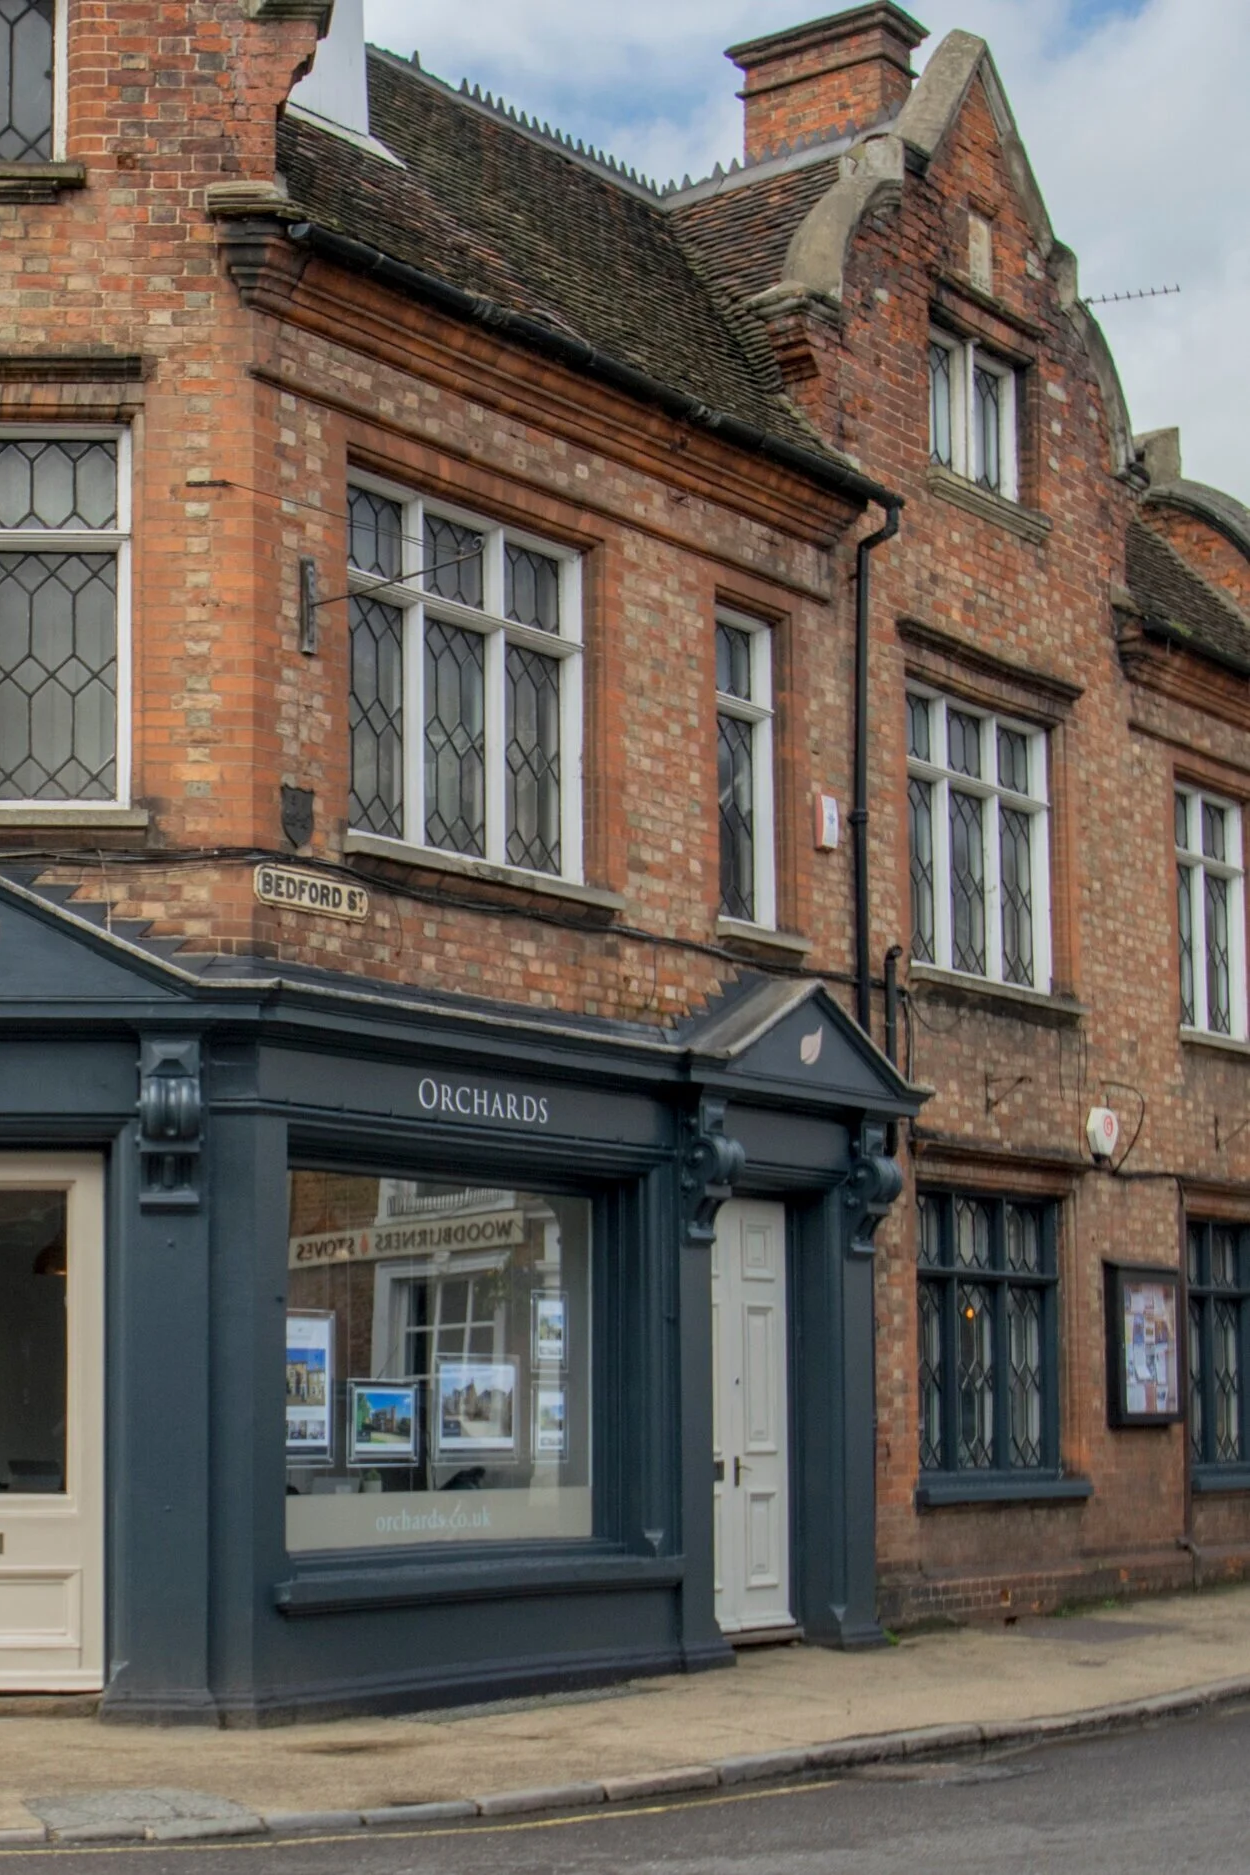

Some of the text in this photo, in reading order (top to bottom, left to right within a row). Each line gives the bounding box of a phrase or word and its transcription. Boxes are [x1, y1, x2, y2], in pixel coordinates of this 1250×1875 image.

[261, 871, 343, 909] BEDFORD
[418, 1077, 549, 1124] ORCHARDS
[375, 1504, 491, 1533] orchards.co.uk
